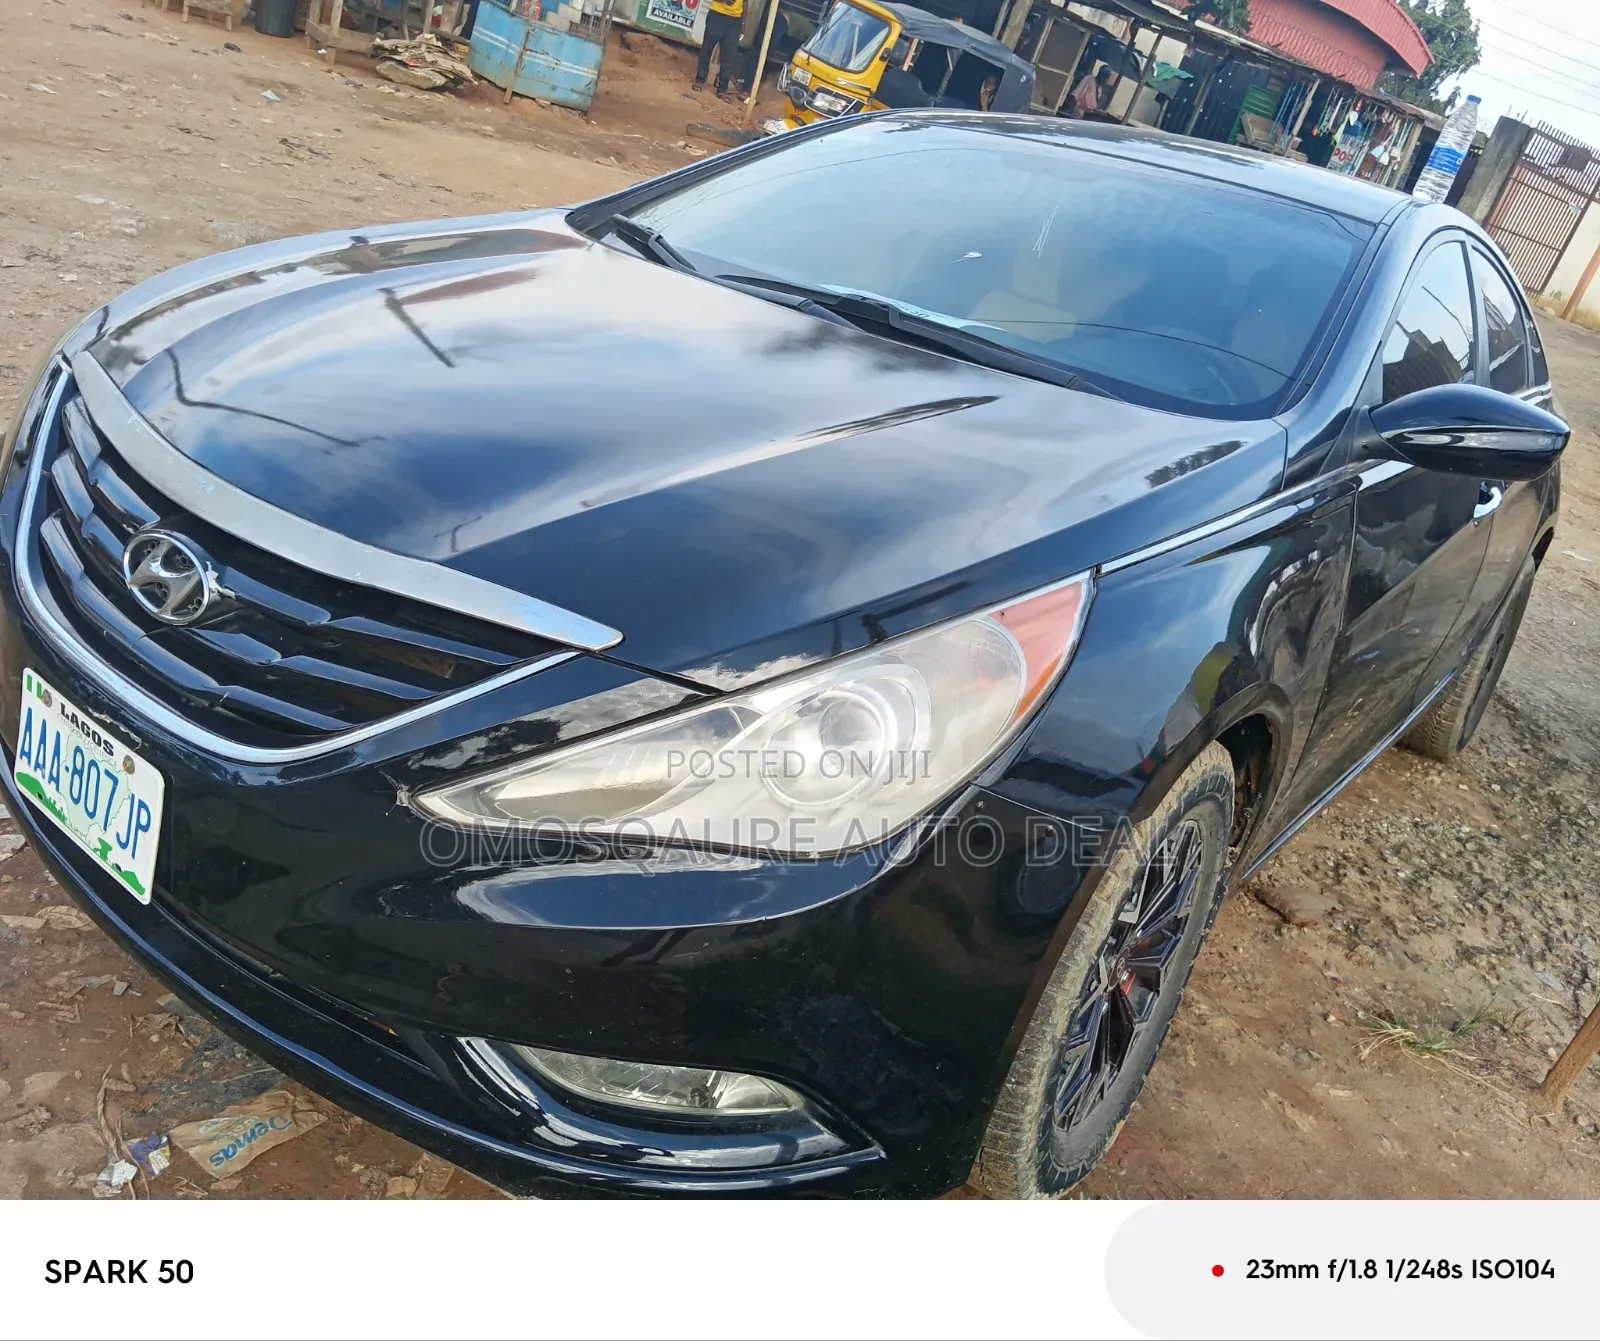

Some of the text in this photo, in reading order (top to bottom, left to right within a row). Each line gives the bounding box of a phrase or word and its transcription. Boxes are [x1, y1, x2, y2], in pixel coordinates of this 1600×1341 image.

[653, 9, 692, 27] AVAILABLE
[60, 702, 114, 757] LAGOS
[19, 706, 152, 860] AAA-807 JP
[208, 1114, 293, 1169] Demas
